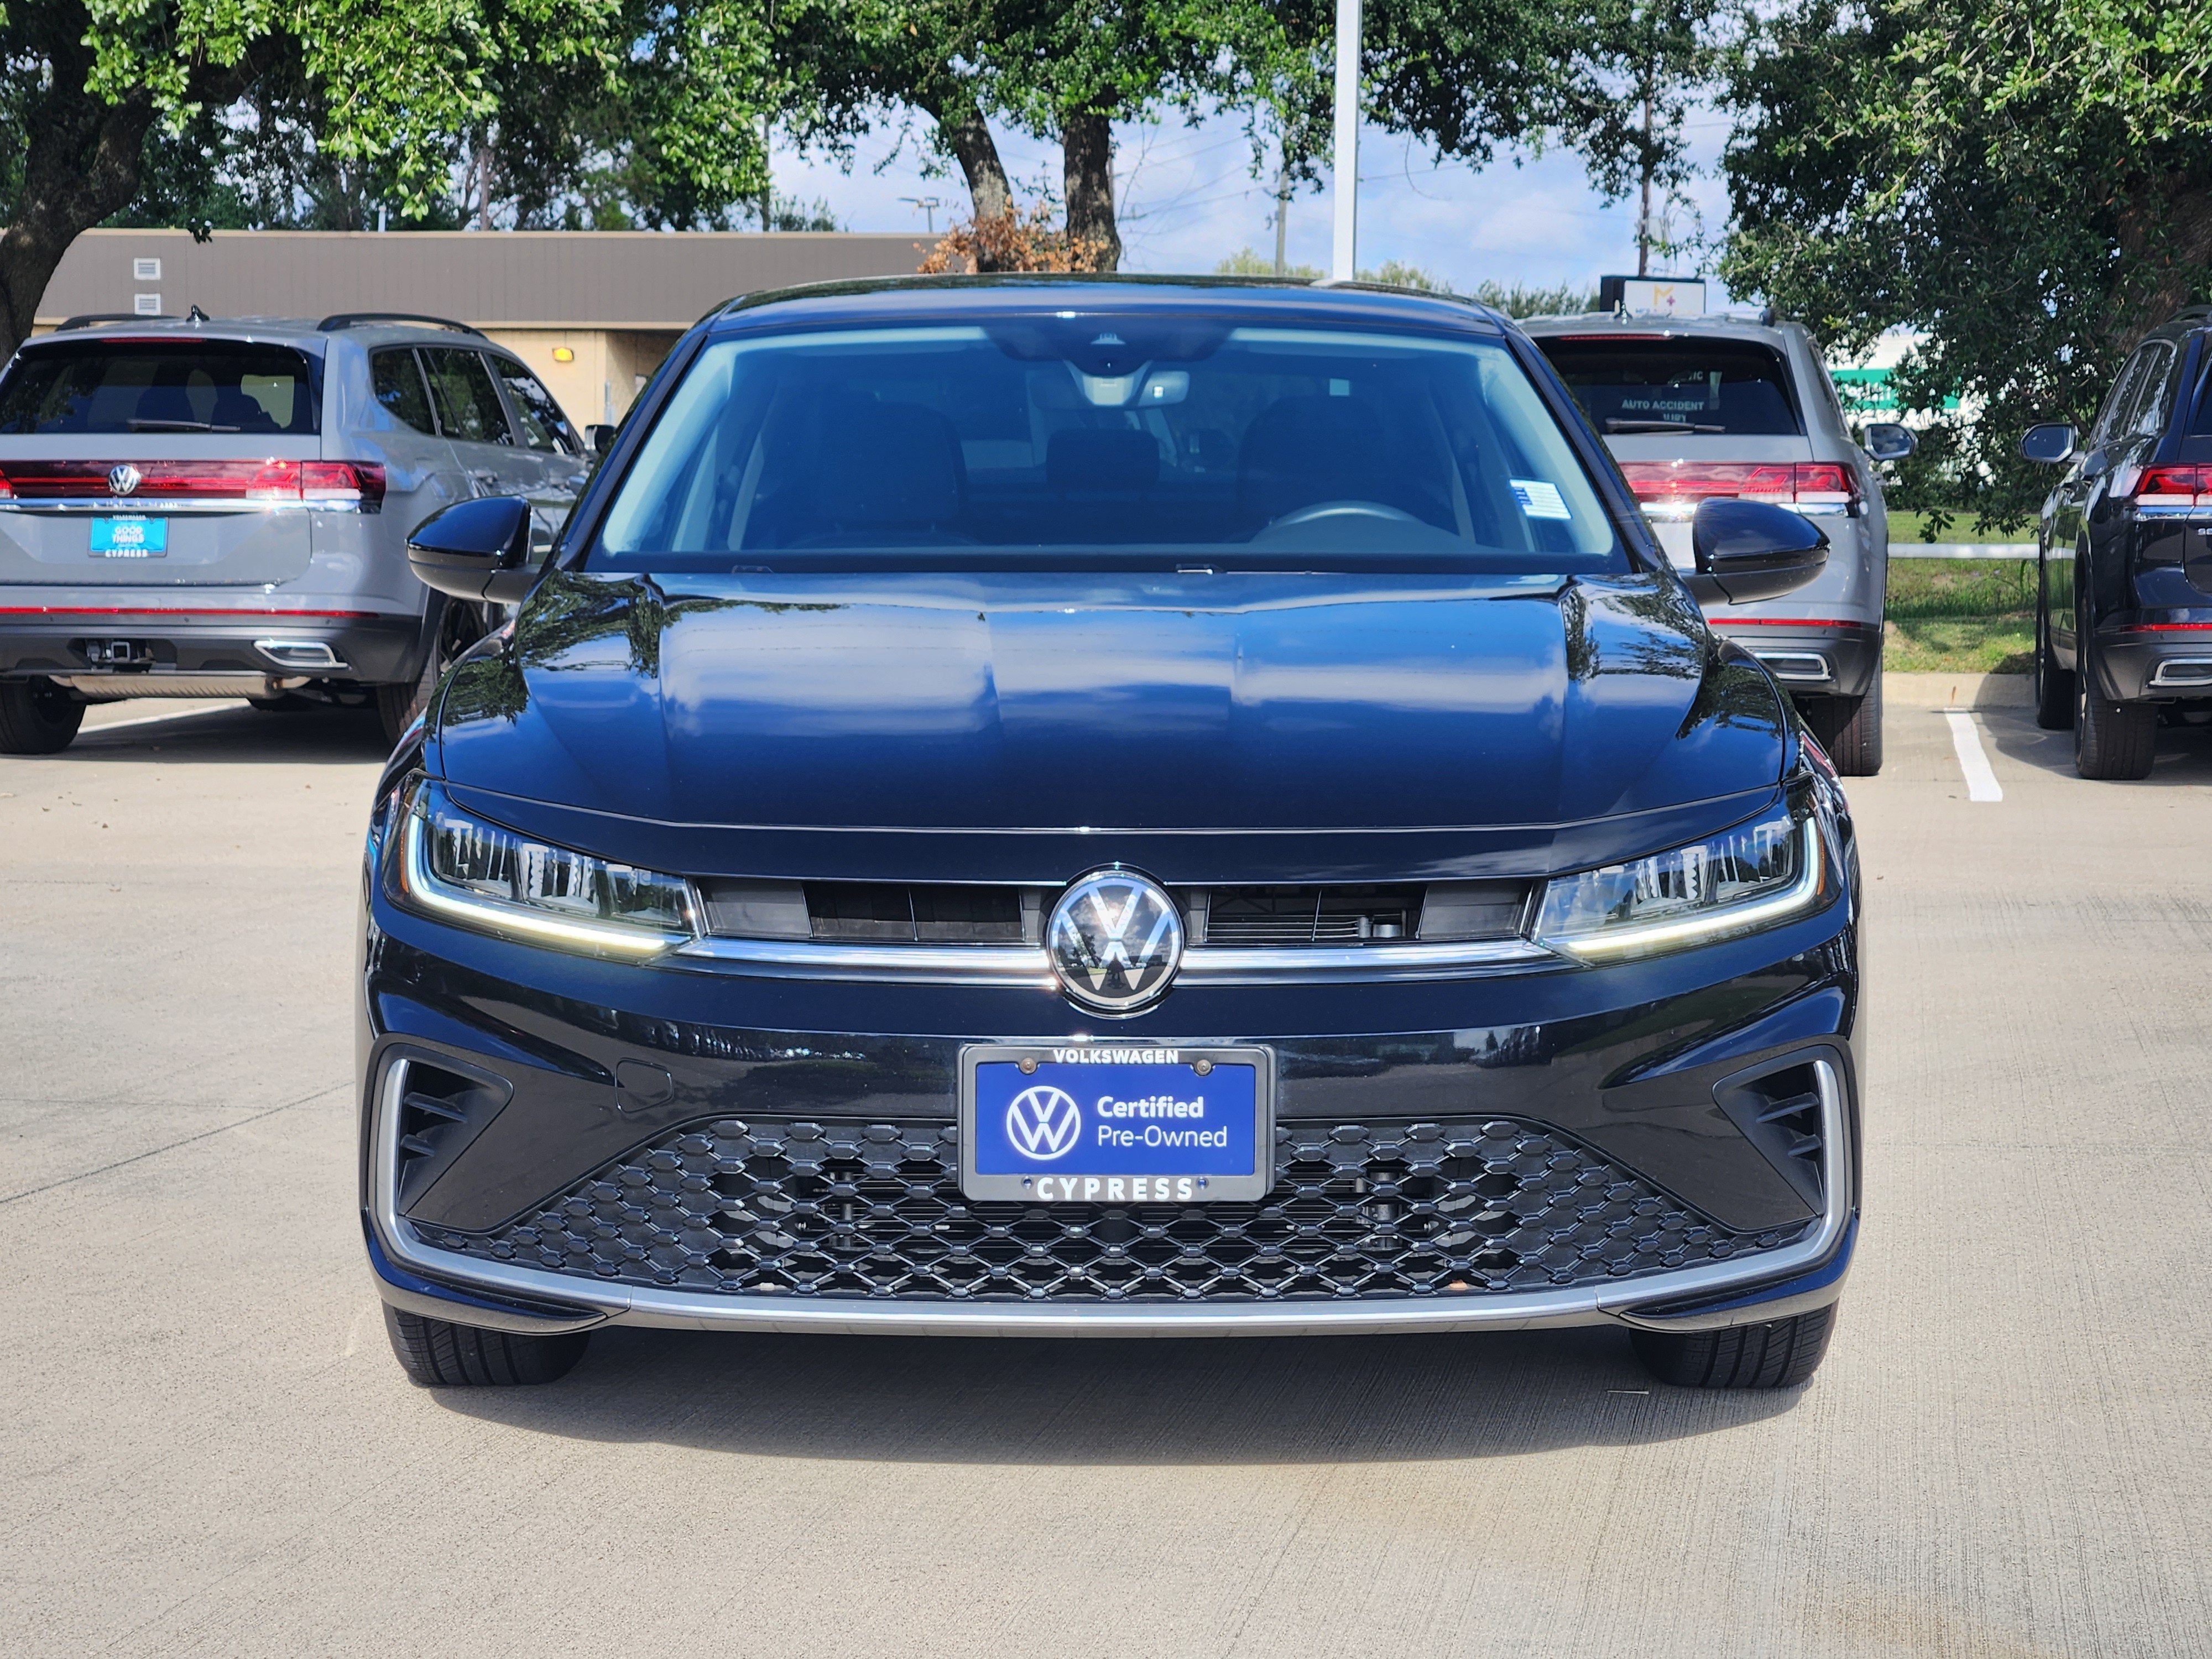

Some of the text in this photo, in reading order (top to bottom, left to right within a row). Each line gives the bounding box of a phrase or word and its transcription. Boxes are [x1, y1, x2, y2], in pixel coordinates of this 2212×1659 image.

[1622, 399, 1704, 410] AUTO ACCIDENT
[105, 549, 148, 557] CYPRESS
[1051, 877, 1180, 1005] VW
[1053, 1050, 1178, 1064] VOLKSWAGEN
[1097, 1096, 1203, 1118] Certified
[1006, 1086, 1081, 1160] VW
[1098, 1125, 1227, 1147] Pre-Owned
[1037, 1177, 1192, 1200] CYPRESS
